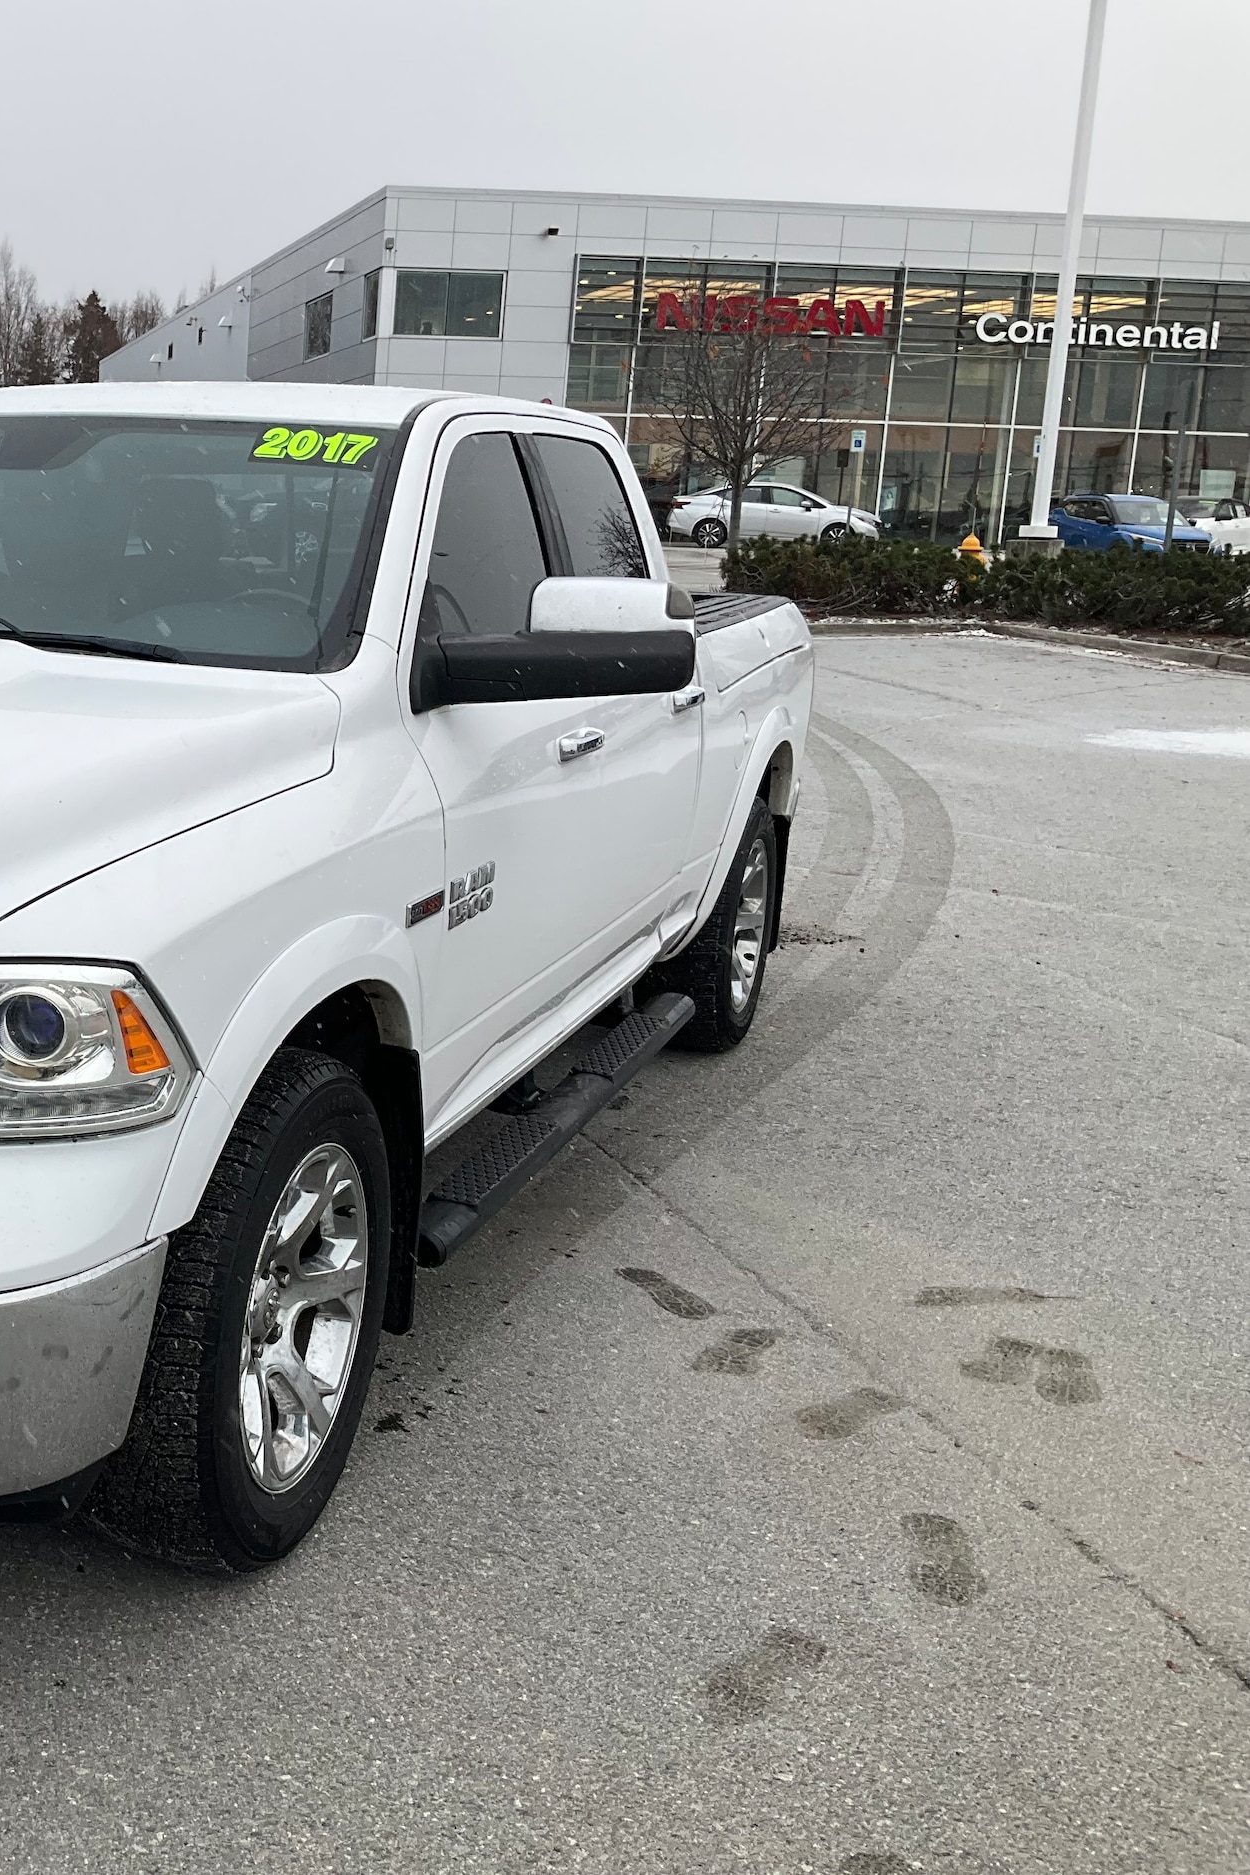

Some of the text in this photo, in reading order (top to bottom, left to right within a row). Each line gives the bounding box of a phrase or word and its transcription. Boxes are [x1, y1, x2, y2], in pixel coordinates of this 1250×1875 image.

[656, 293, 886, 336] NISSAN
[253, 427, 379, 464] 2017
[449, 860, 495, 905] RAM
[448, 886, 494, 931] 1500
